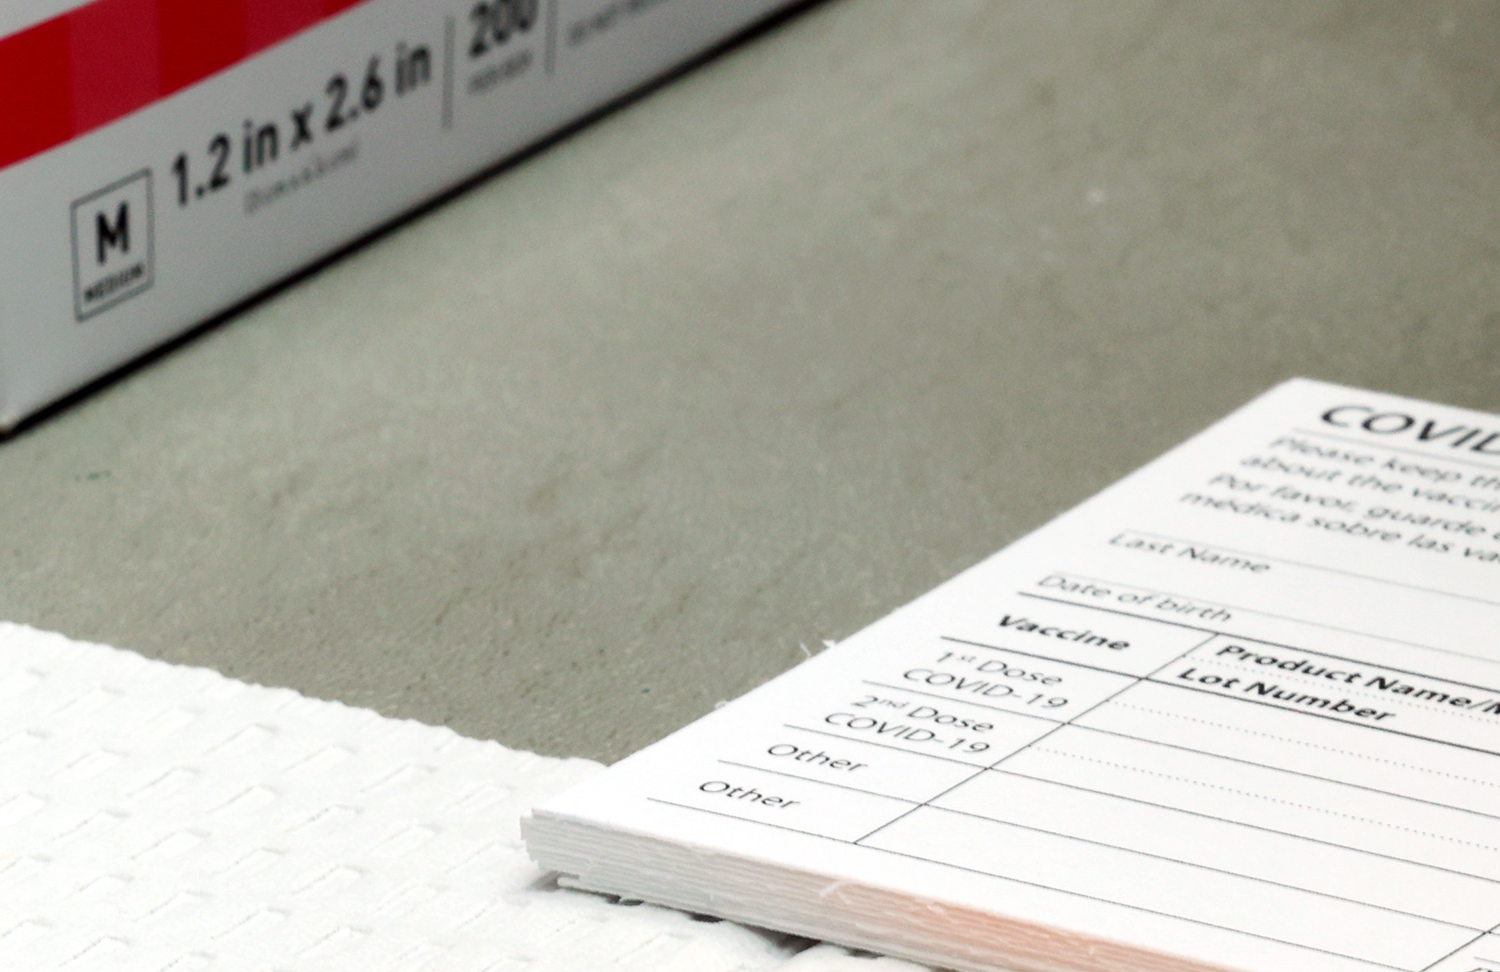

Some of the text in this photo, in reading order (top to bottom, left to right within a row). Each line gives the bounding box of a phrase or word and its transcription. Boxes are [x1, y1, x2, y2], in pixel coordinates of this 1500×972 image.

[173, 131, 231, 206] 1.2
[243, 118, 278, 174] in
[290, 102, 313, 149] x
[326, 53, 385, 132] 2.6
[395, 40, 432, 96] in
[95, 199, 130, 266] M
[1348, 473, 1403, 491] the
[1108, 532, 1271, 573] Last Name
[1037, 575, 1232, 622] Date of birth
[998, 614, 1131, 651] Vaccine
[976, 659, 1064, 686] Dose
[1215, 644, 1362, 684] Product
[902, 668, 1069, 709] COVID-19
[1176, 667, 1396, 722] Lot Number
[823, 712, 991, 754] COVID-19
[906, 706, 995, 732] Dose
[766, 743, 869, 772] Other
[699, 780, 801, 809] Other
